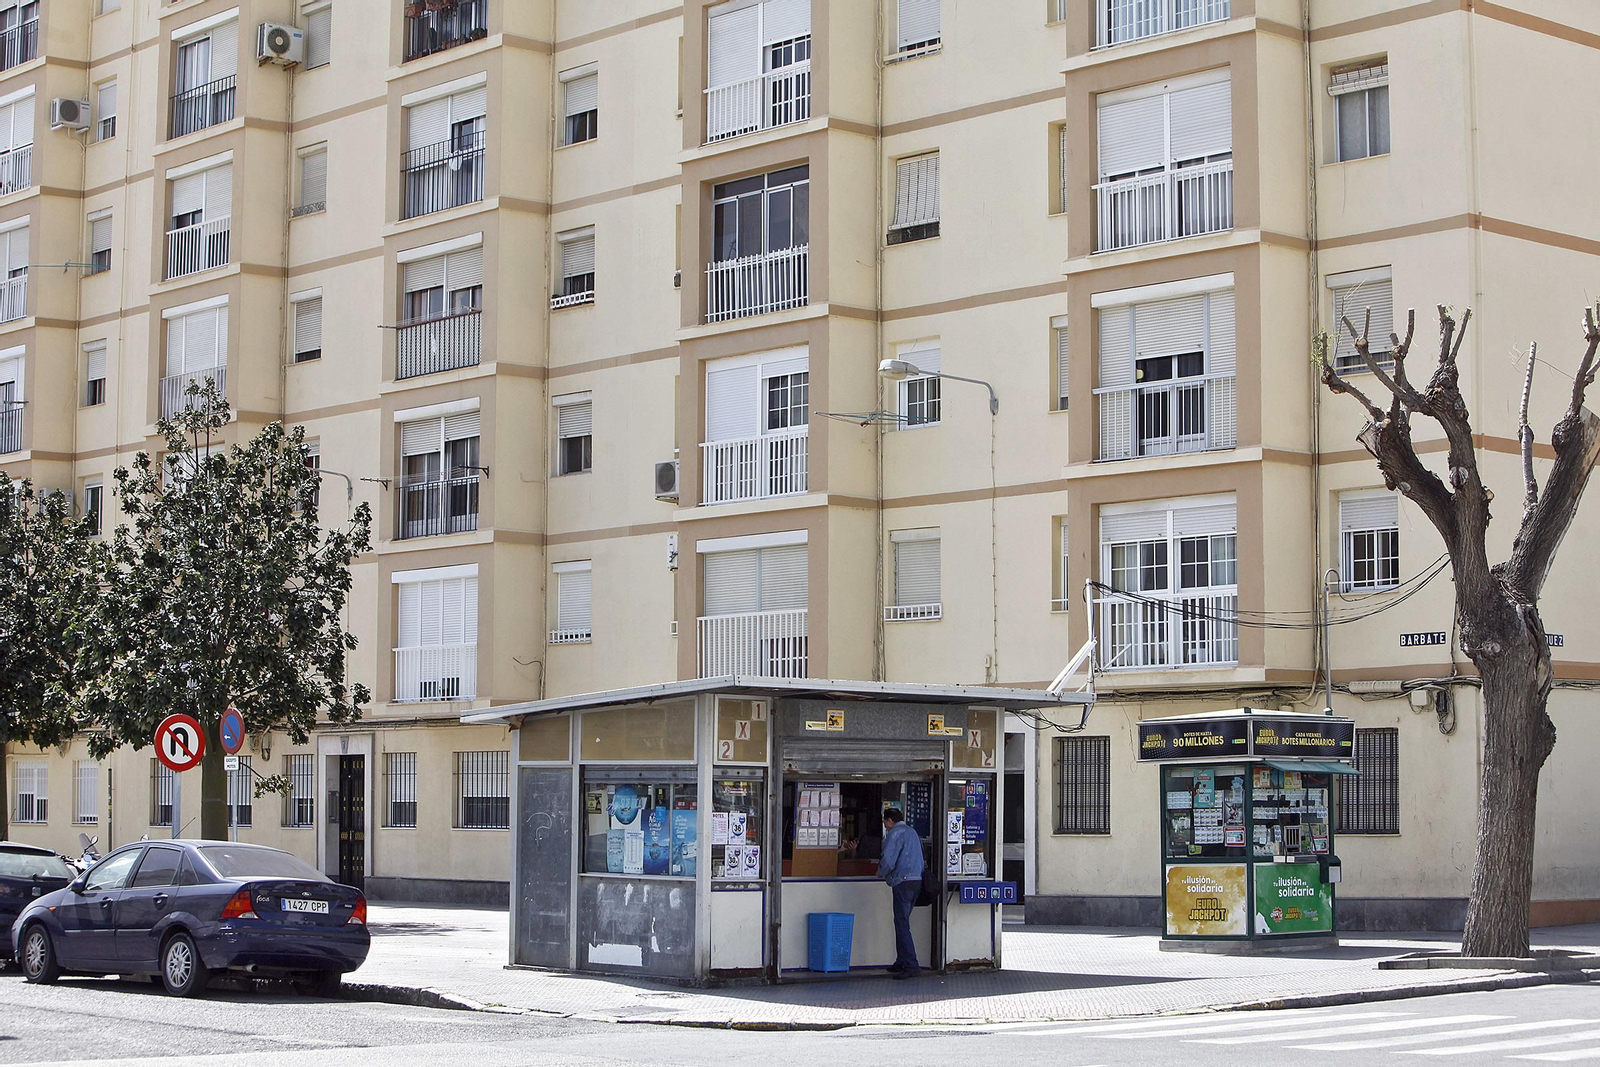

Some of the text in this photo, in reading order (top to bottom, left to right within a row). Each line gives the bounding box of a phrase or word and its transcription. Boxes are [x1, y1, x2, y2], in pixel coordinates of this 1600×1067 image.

[1400, 633, 1445, 645] BARBATE
[756, 703, 761, 719] 1
[738, 721, 747, 738] X
[970, 731, 978, 747] X
[1173, 738, 1184, 747] 90
[1185, 736, 1224, 747] MILLONES
[1282, 738, 1298, 746] BOTES
[1299, 738, 1335, 746] MILLONARIOS
[722, 741, 730, 758] 2
[1187, 876, 1211, 884] ilusión
[1278, 877, 1302, 886] ilusión
[1187, 884, 1224, 893] solidaria
[1278, 886, 1314, 897] solidaria
[287, 900, 327, 912] 1427 CPP
[1196, 898, 1217, 909] EURO
[1189, 909, 1226, 921] JACKPOT
